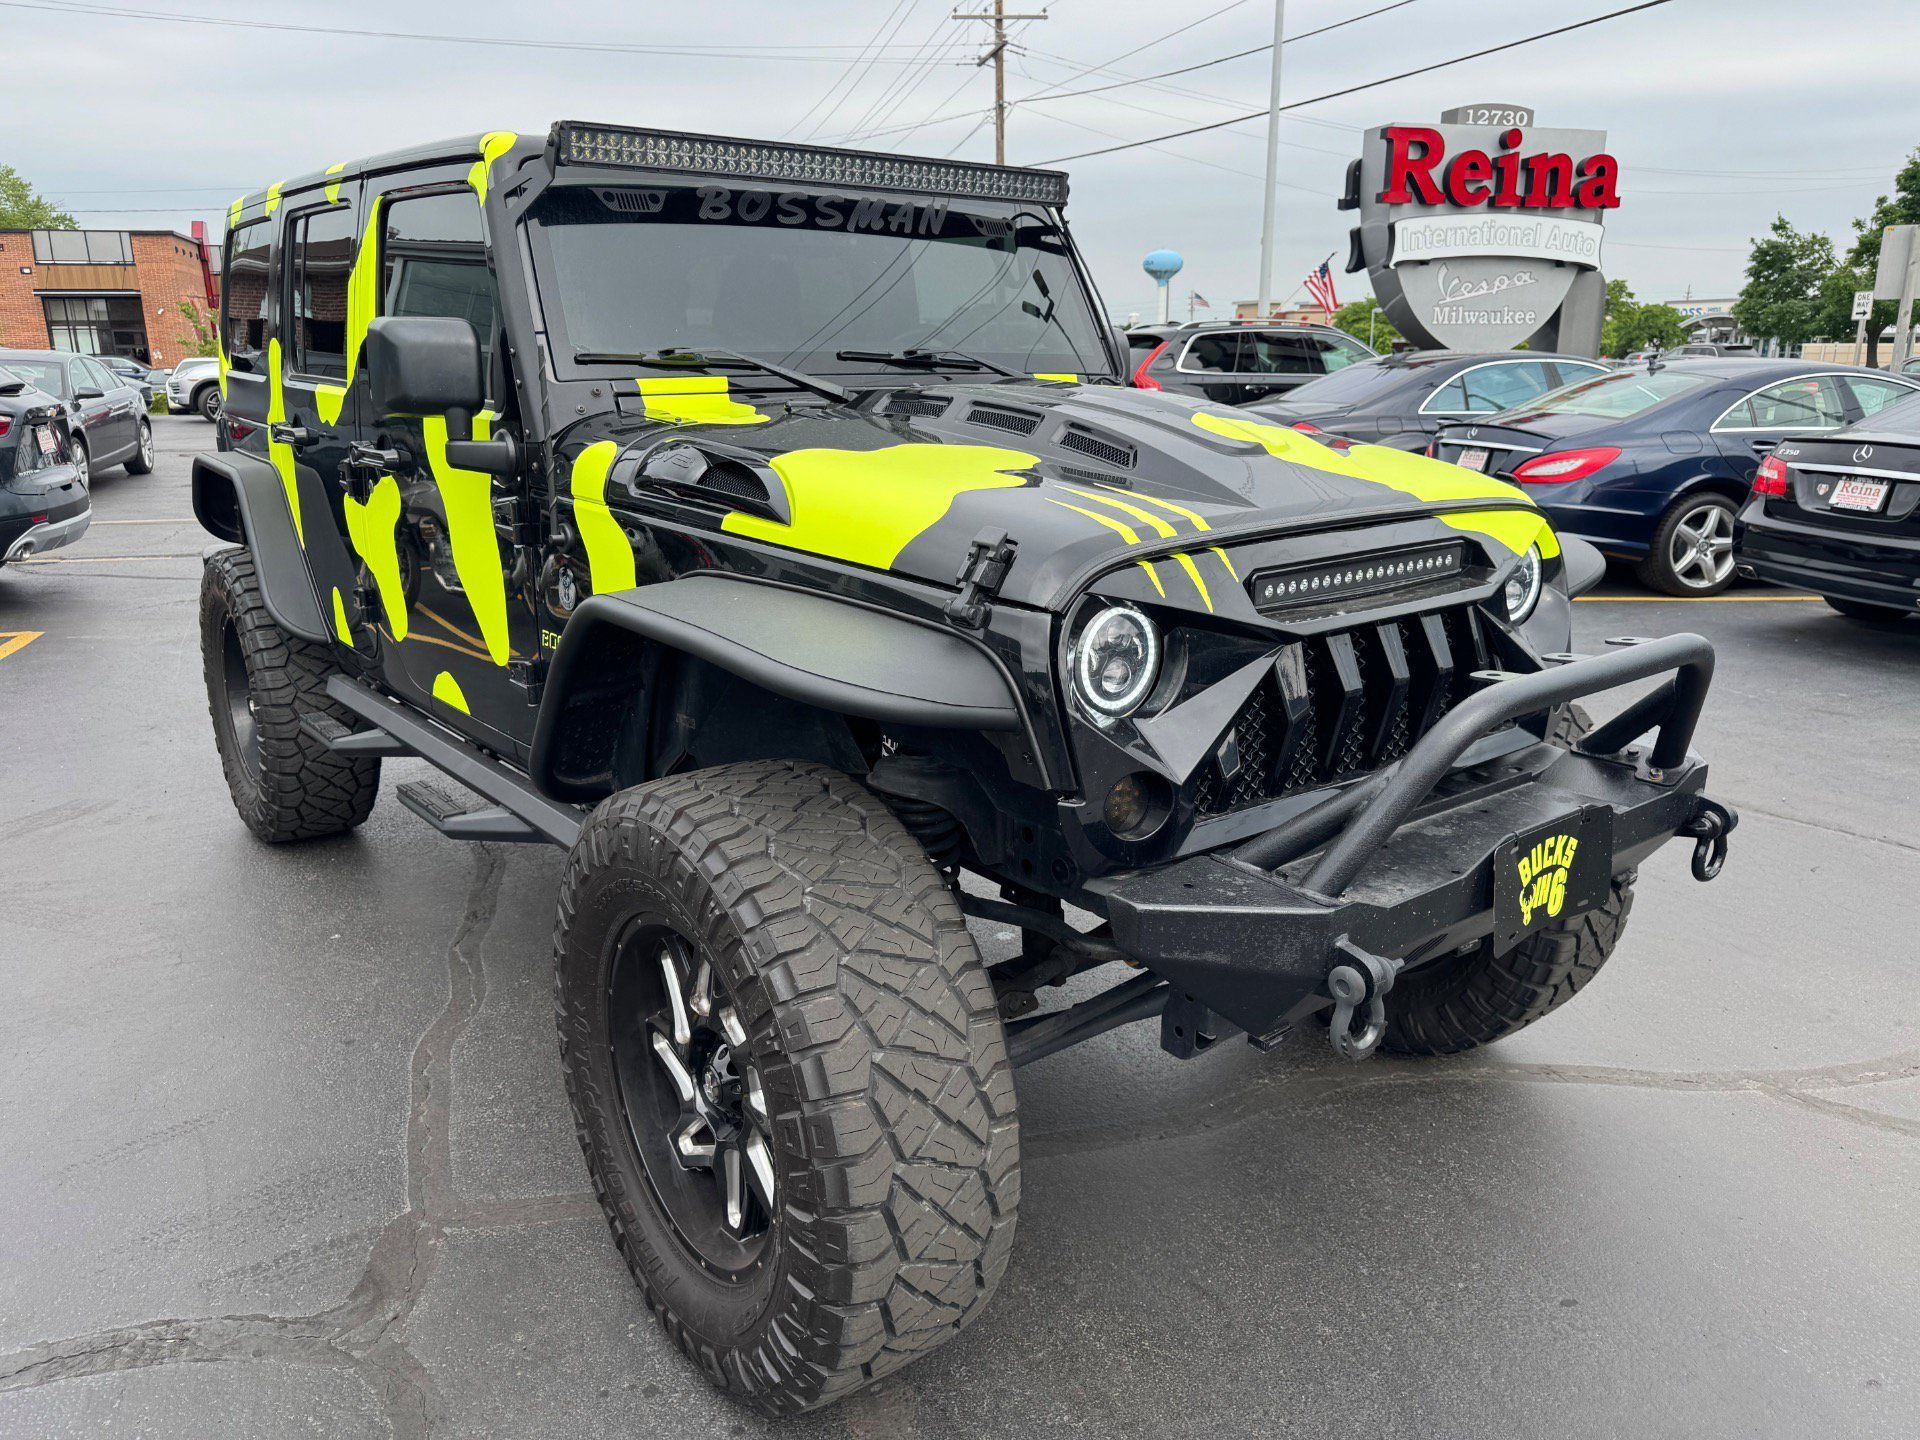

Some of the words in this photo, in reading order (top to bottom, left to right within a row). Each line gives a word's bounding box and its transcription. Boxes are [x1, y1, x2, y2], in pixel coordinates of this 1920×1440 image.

[1465, 109, 1528, 126] 12730
[1376, 127, 1620, 208] Reina
[696, 185, 947, 235] BOSSMAN
[1402, 220, 1541, 252] International
[1545, 227, 1596, 256] Auto
[1437, 263, 1540, 305] Vespa
[1857, 293, 1871, 301] ONE
[1432, 307, 1536, 325] Milwaukee
[1840, 481, 1881, 497] Reina
[1517, 834, 1579, 887] BUCKS
